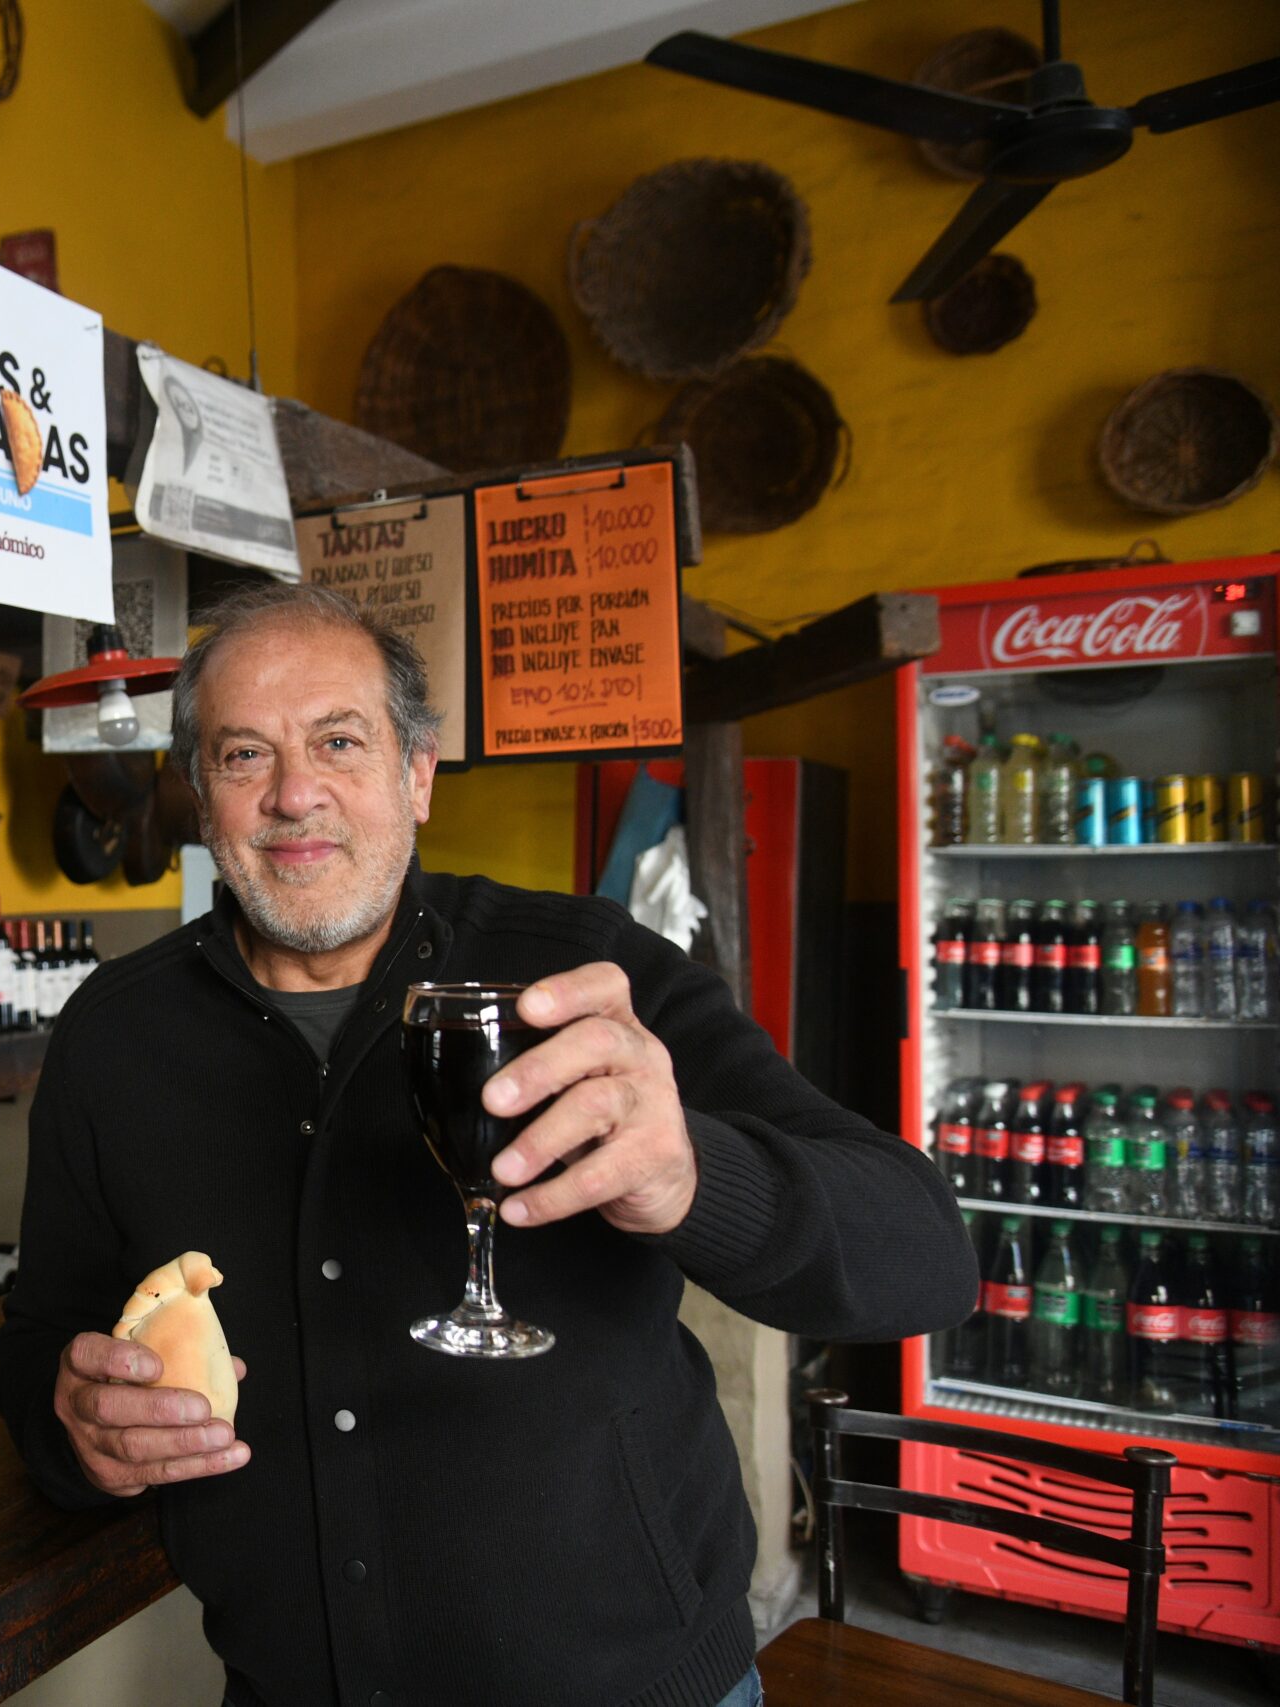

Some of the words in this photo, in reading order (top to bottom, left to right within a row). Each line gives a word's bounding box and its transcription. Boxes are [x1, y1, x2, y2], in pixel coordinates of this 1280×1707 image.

[30, 368, 53, 414] &
[487, 512, 566, 547] LOCRO
[492, 597, 551, 624] PRECIOS
[556, 595, 583, 618] POR
[491, 627, 514, 649] NO
[520, 620, 580, 645] INCLUYE
[590, 619, 620, 643] PAN
[991, 594, 1195, 663] Coca-Cola
[492, 654, 515, 678] NO
[522, 649, 582, 675] INCLUYE
[590, 643, 645, 668] ENVASE
